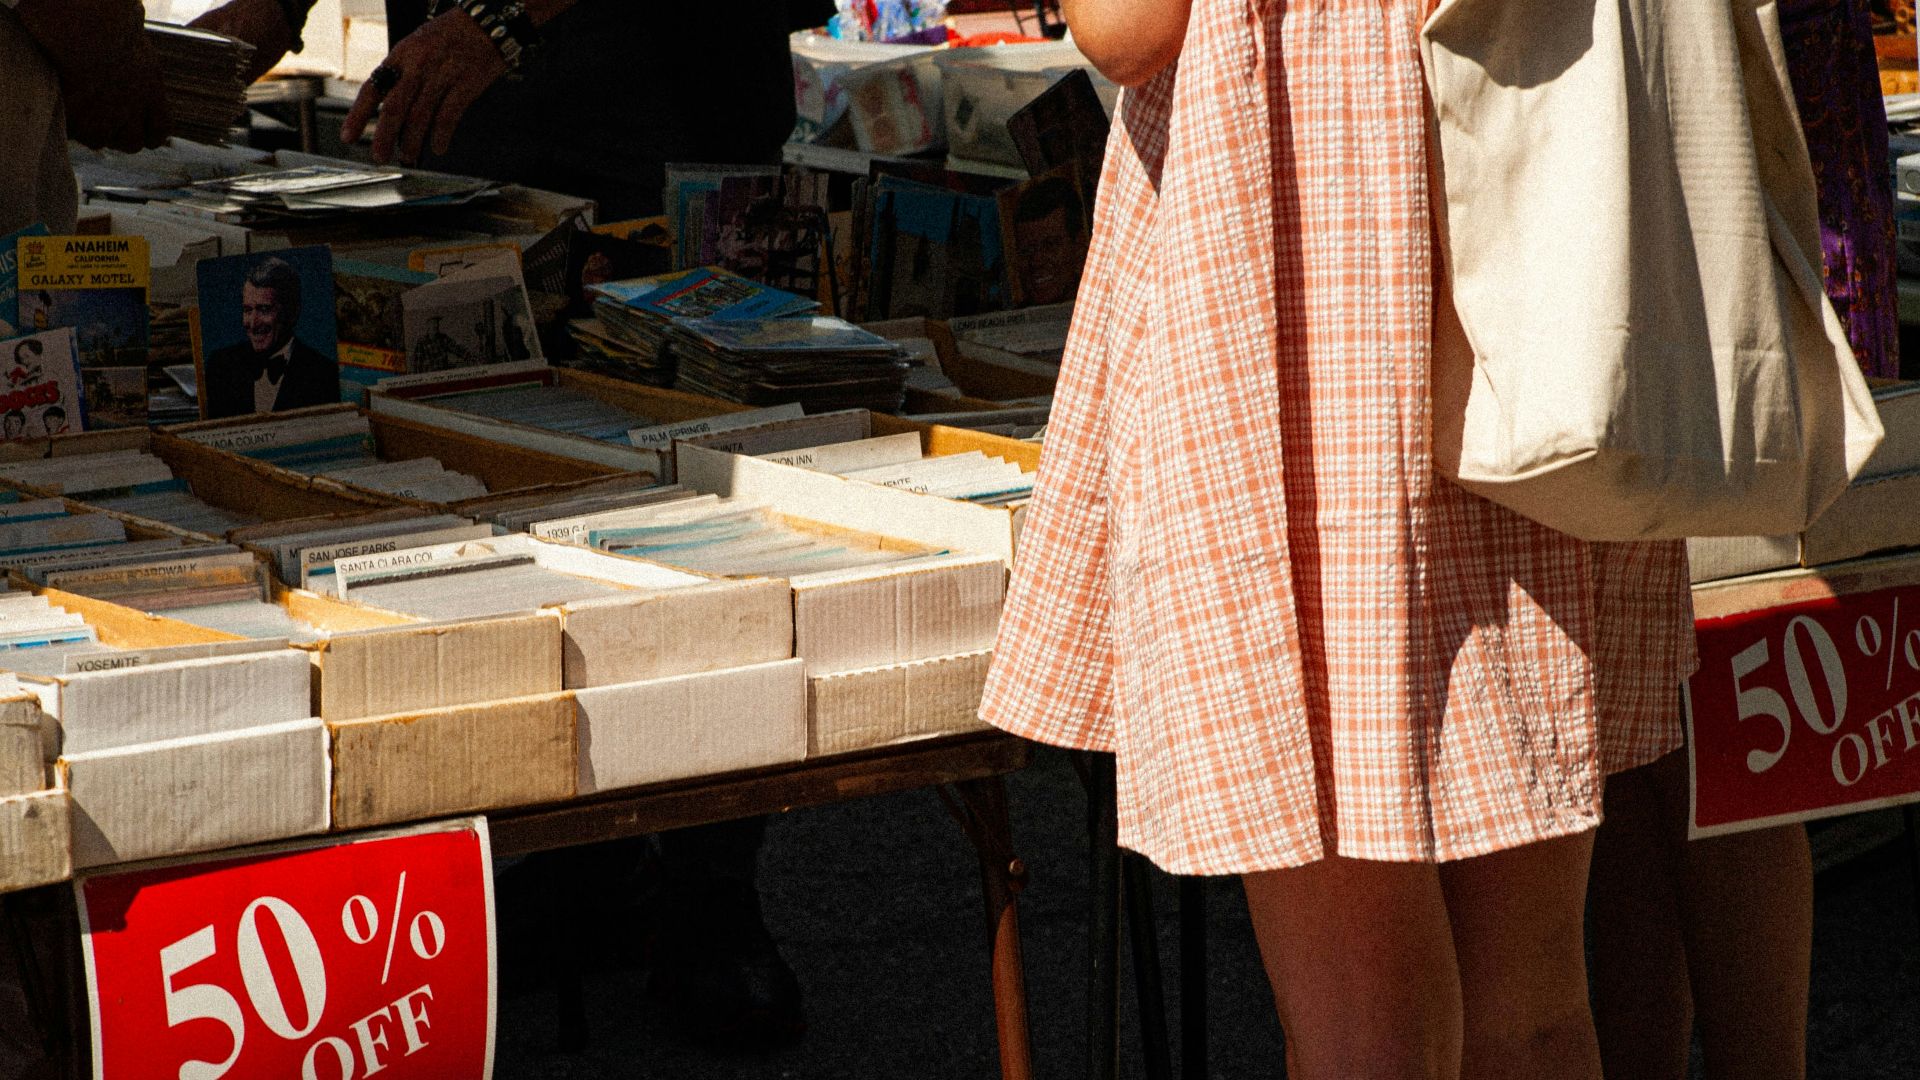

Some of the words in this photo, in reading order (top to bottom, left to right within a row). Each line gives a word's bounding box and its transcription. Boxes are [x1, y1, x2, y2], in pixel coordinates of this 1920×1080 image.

[65, 241, 129, 252] ANAHEIM
[74, 255, 120, 263] CALIFORNIA
[31, 274, 84, 285] GALAXY
[91, 273, 135, 284] MOTEL
[235, 433, 276, 447] COUNTY
[642, 431, 667, 443] PALM
[669, 422, 711, 437] SPRINGS
[795, 454, 812, 465] INN
[547, 527, 569, 538] 1939
[309, 550, 330, 563] SAN
[332, 546, 359, 558] JOSE
[361, 541, 396, 555] PARKS
[127, 563, 197, 580] BOARDWALK
[340, 558, 375, 573] SANTA
[377, 555, 412, 568] CLARA
[76, 656, 140, 671] YOSEMITE
[1831, 690, 1920, 787] OFF
[159, 869, 446, 1080] 50%
[300, 984, 435, 1080] OFF
